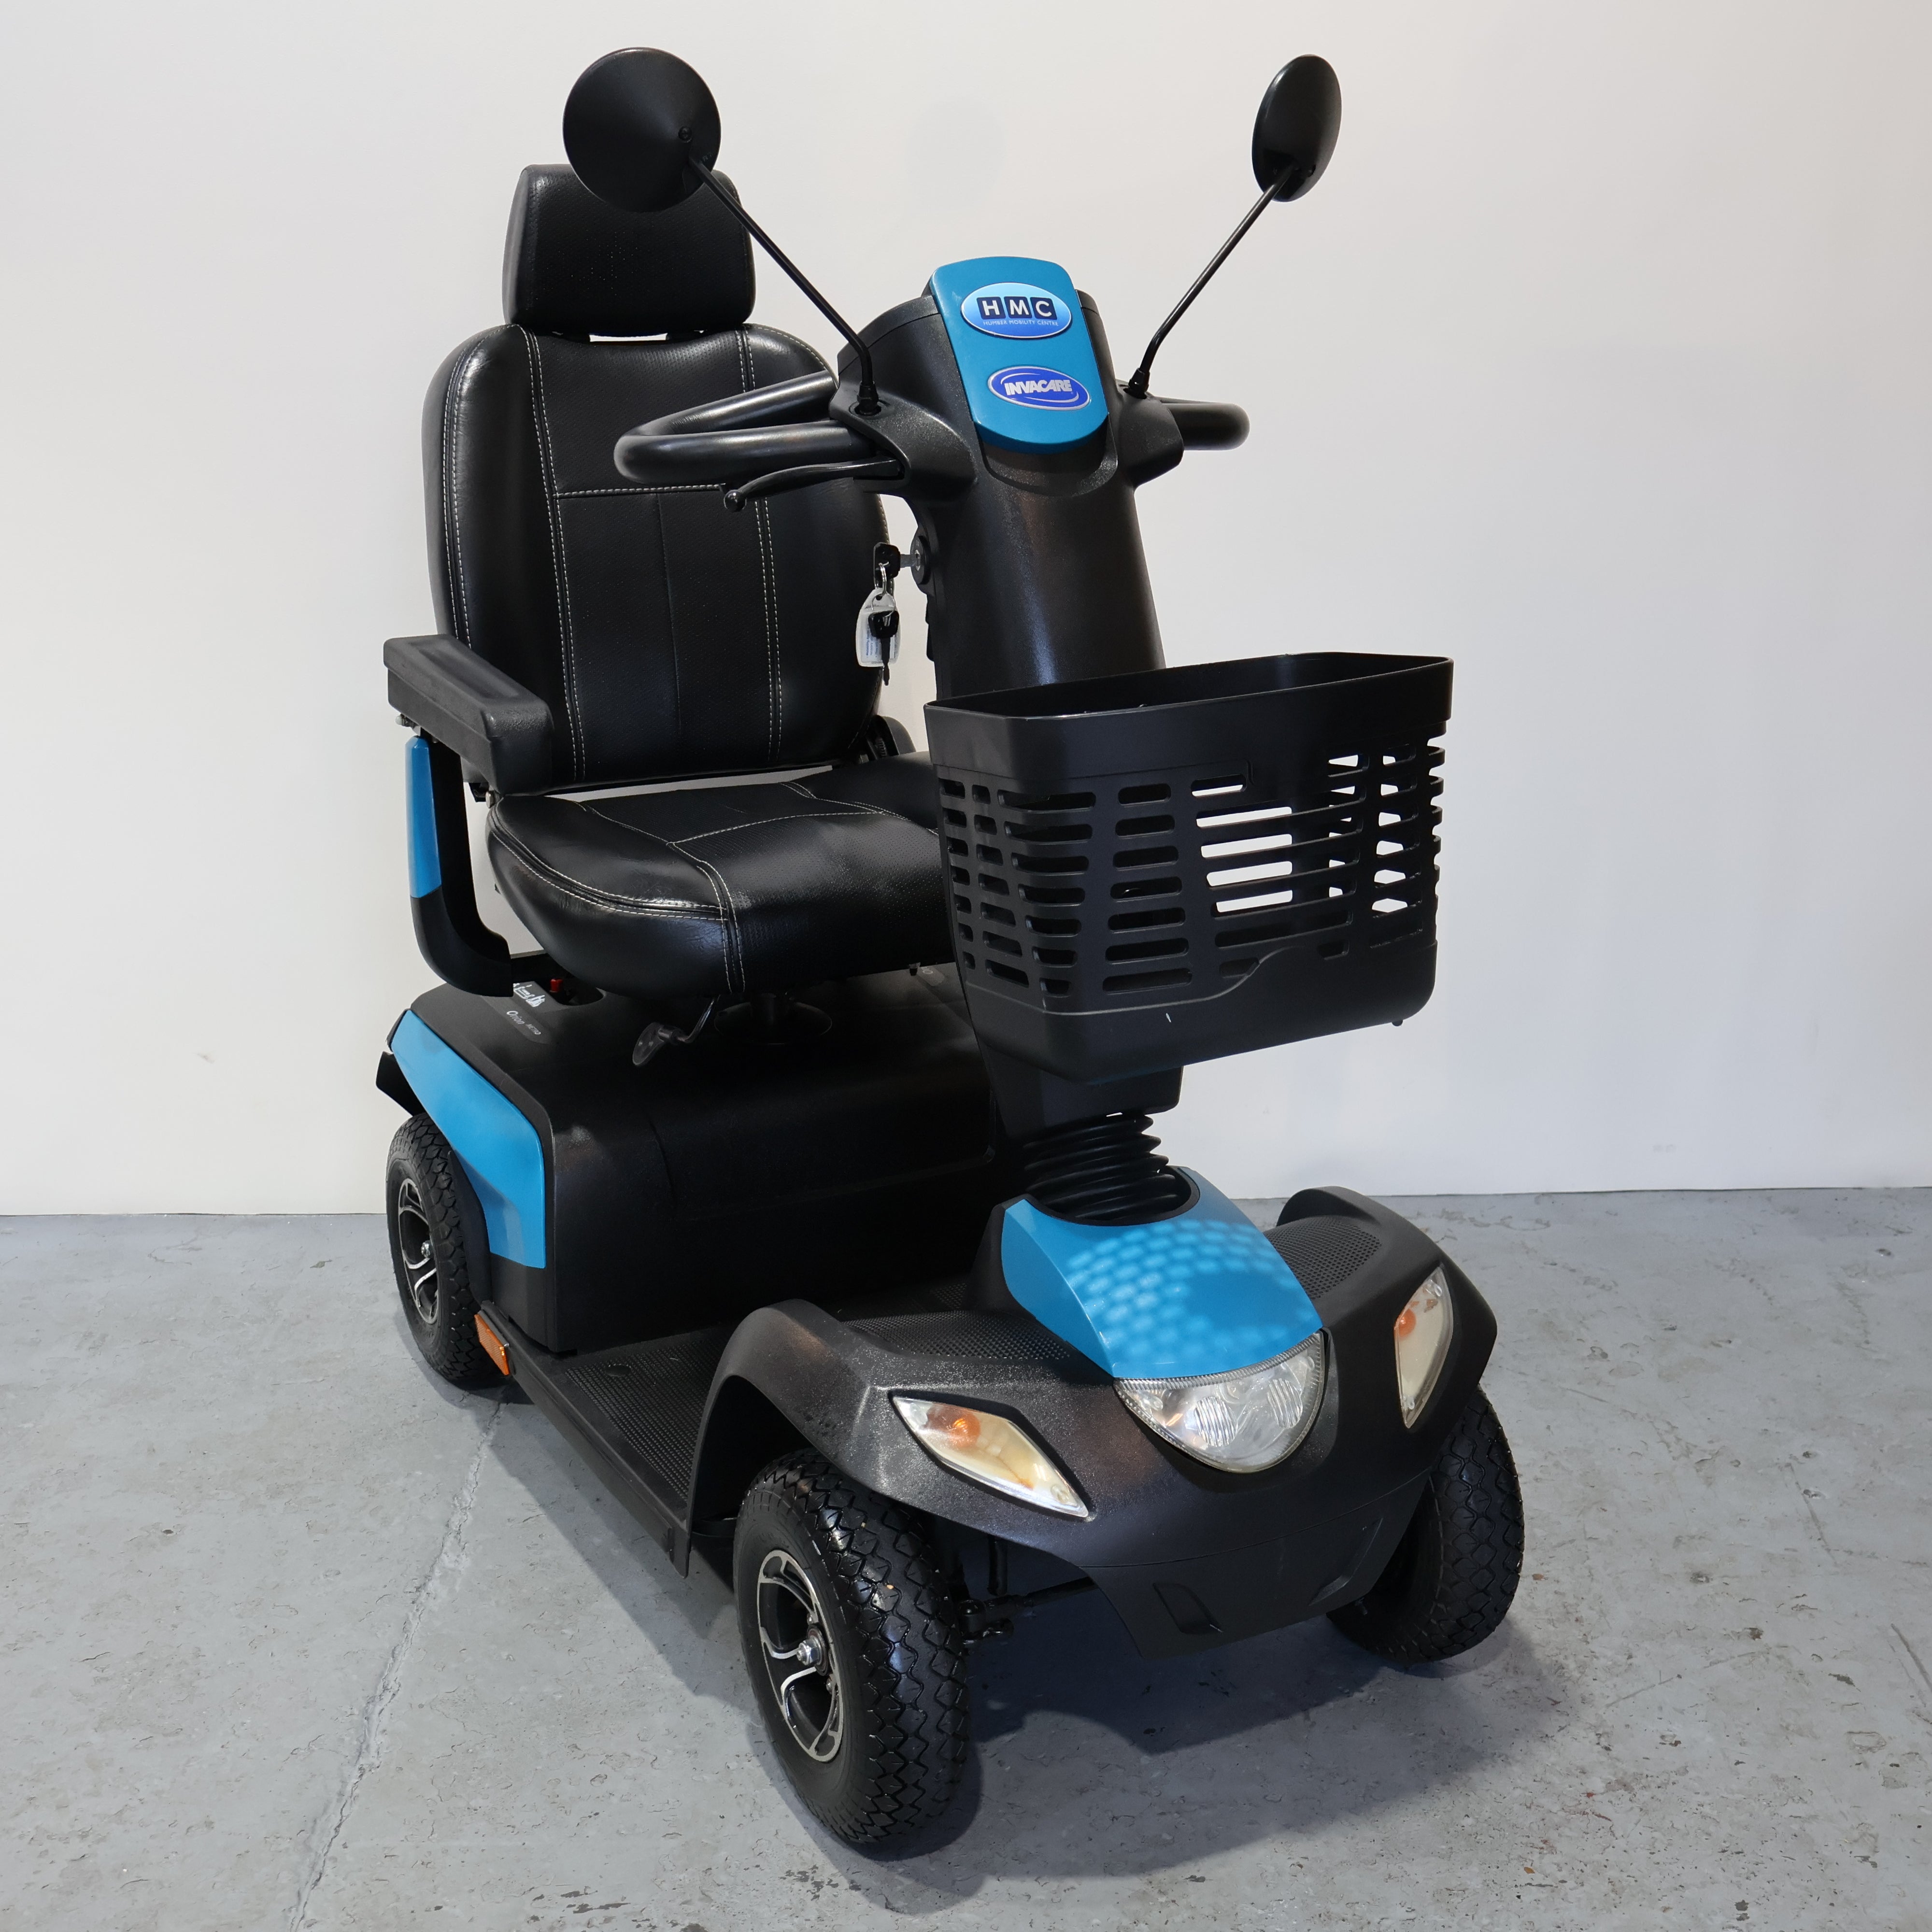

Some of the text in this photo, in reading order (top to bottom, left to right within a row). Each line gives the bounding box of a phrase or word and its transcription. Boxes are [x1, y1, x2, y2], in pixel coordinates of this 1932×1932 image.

[982, 299, 1052, 317] HMC
[1004, 379, 1072, 396] INVACARE
[506, 1010, 525, 1024] Orion
